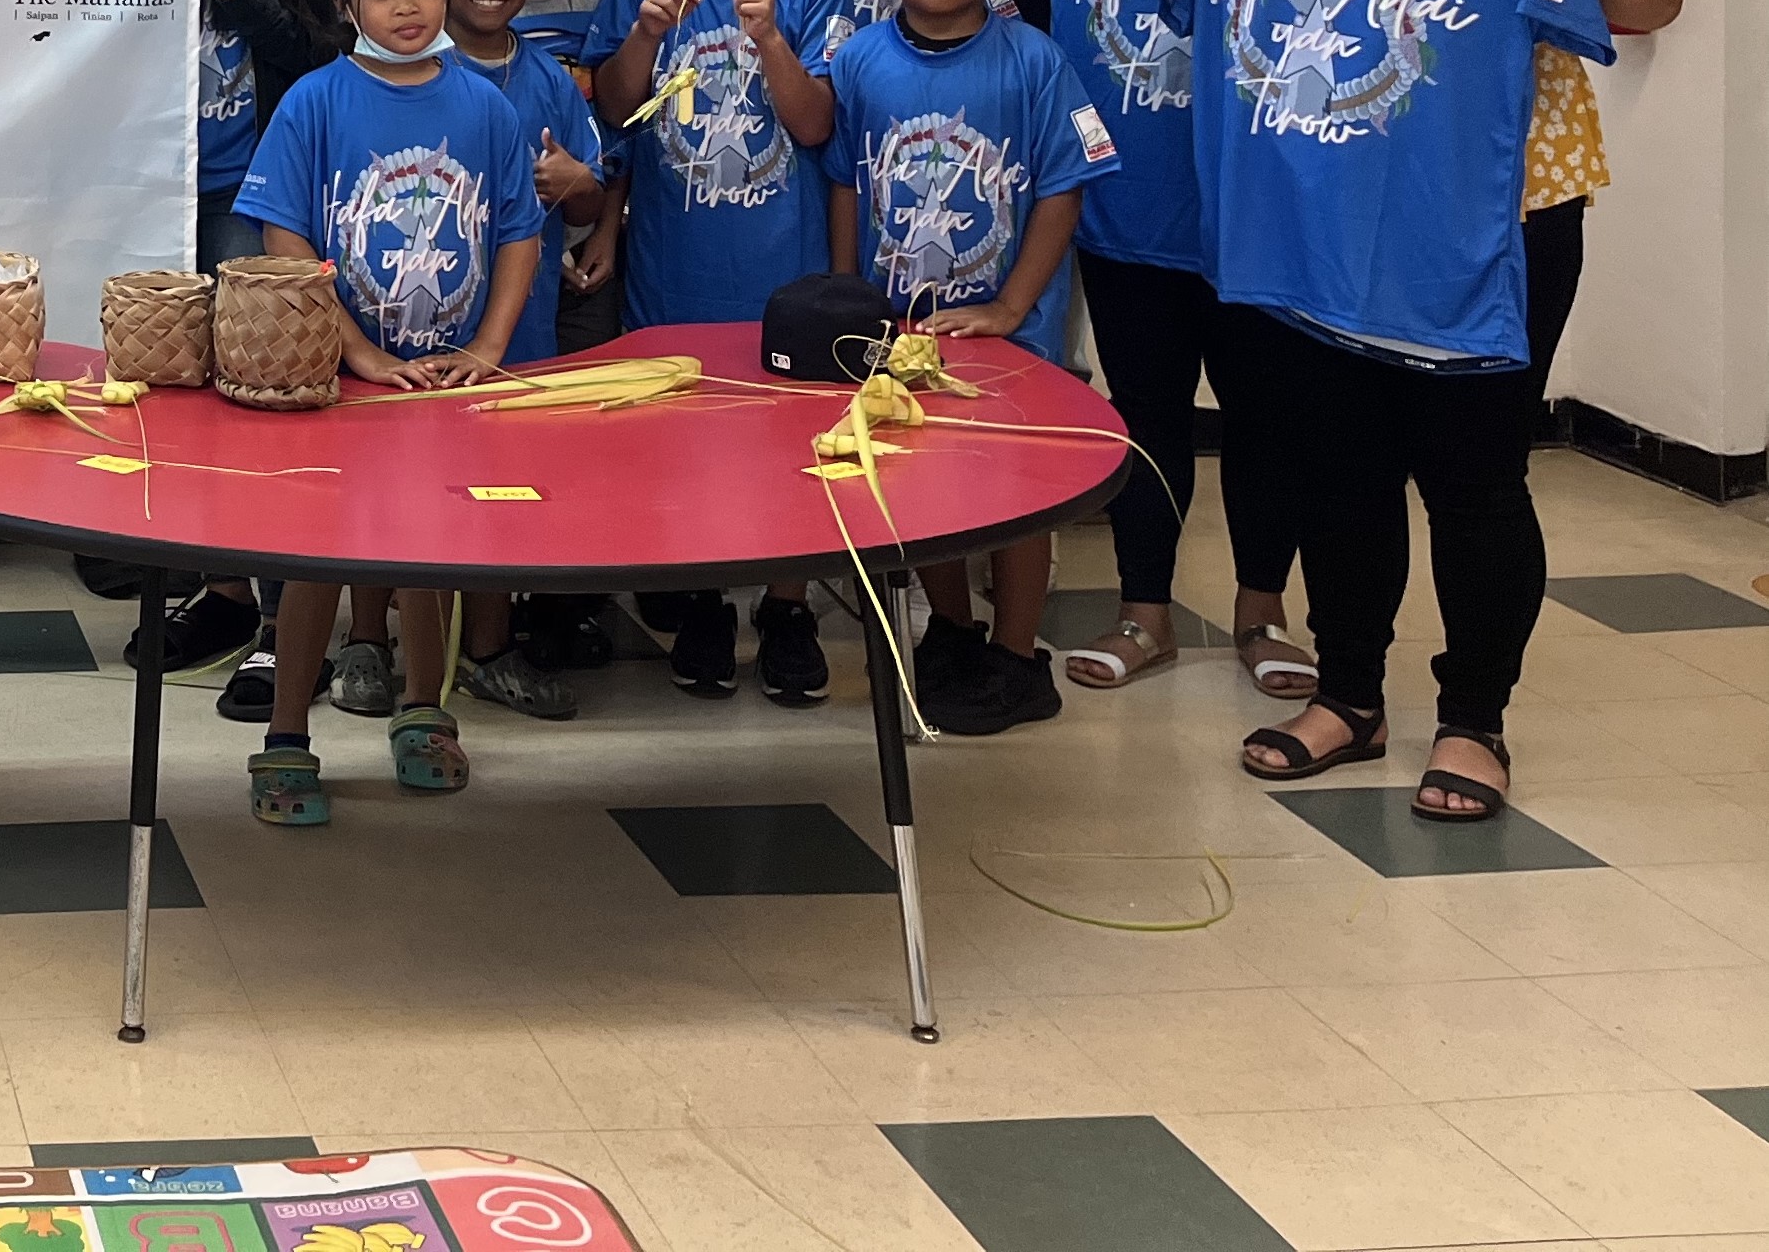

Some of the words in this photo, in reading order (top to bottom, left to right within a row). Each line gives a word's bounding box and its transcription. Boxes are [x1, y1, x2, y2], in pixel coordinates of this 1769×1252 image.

[26, 11, 59, 21] Saipan
[81, 11, 112, 21] Tinian
[137, 12, 158, 21] Rota
[274, 1190, 420, 1219] Banana
